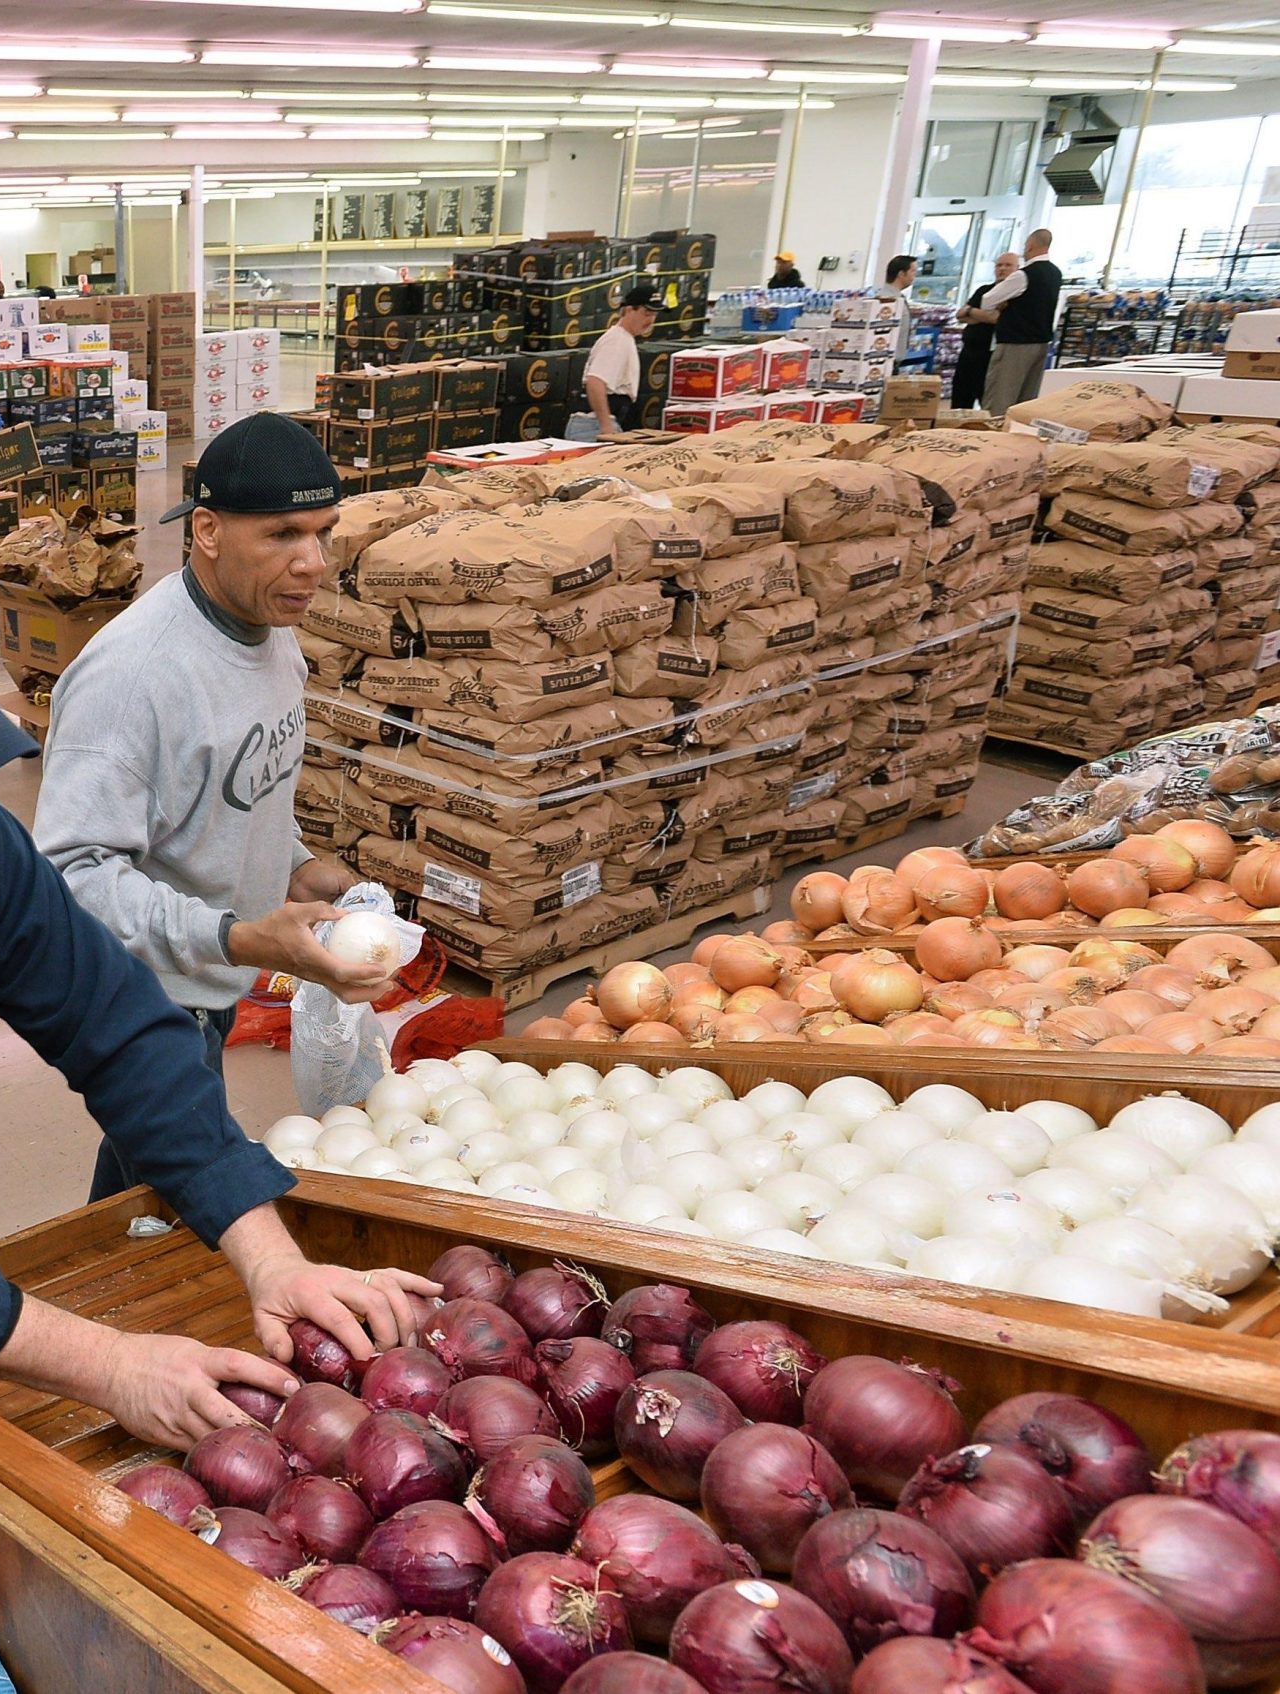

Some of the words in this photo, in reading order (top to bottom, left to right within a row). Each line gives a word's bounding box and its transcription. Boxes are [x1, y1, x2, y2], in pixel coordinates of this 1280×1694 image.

[141, 418, 156, 430] sk
[432, 635, 451, 645] BAGS
[396, 676, 440, 687] POTATOES
